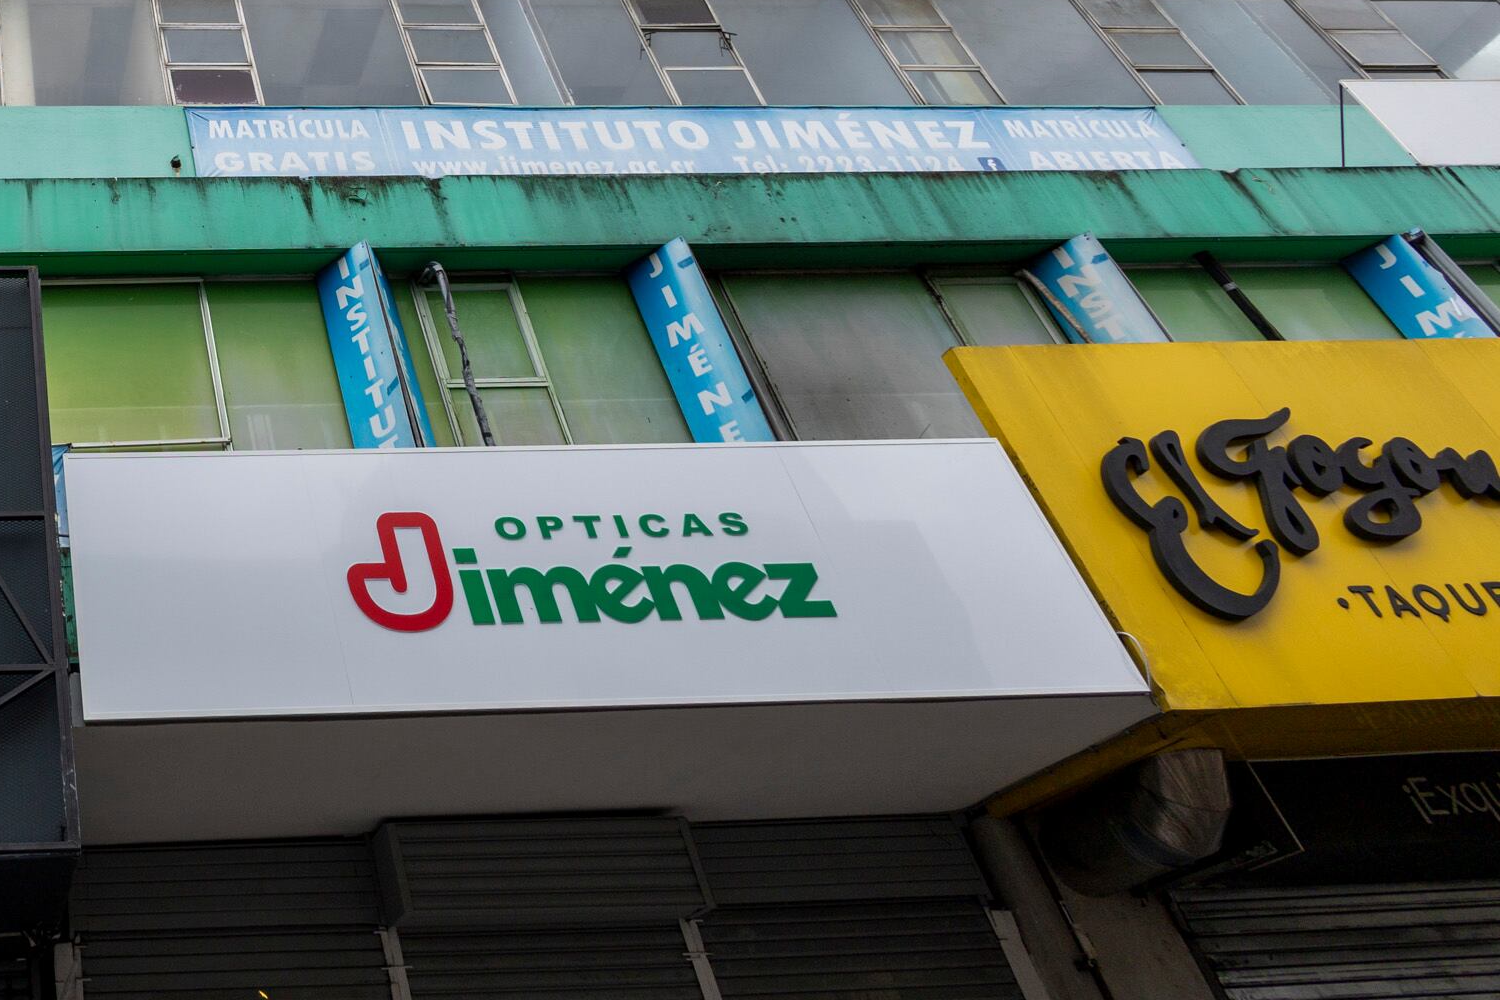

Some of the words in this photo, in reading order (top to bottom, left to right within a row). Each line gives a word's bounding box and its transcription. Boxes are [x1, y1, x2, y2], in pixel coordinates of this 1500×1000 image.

[208, 114, 371, 140] MATRÍCULA
[400, 119, 710, 151] INSTITUTO
[732, 112, 991, 150] JIMÉNEZ
[1001, 115, 1162, 139] MATRÍCULA
[214, 150, 377, 173] GRATIS
[1029, 150, 1190, 170] ABIERTA
[1375, 244, 1472, 338] JIM
[494, 512, 749, 540] OPTICAS
[1101, 429, 1280, 622] El
[347, 511, 838, 633] Jiménez
